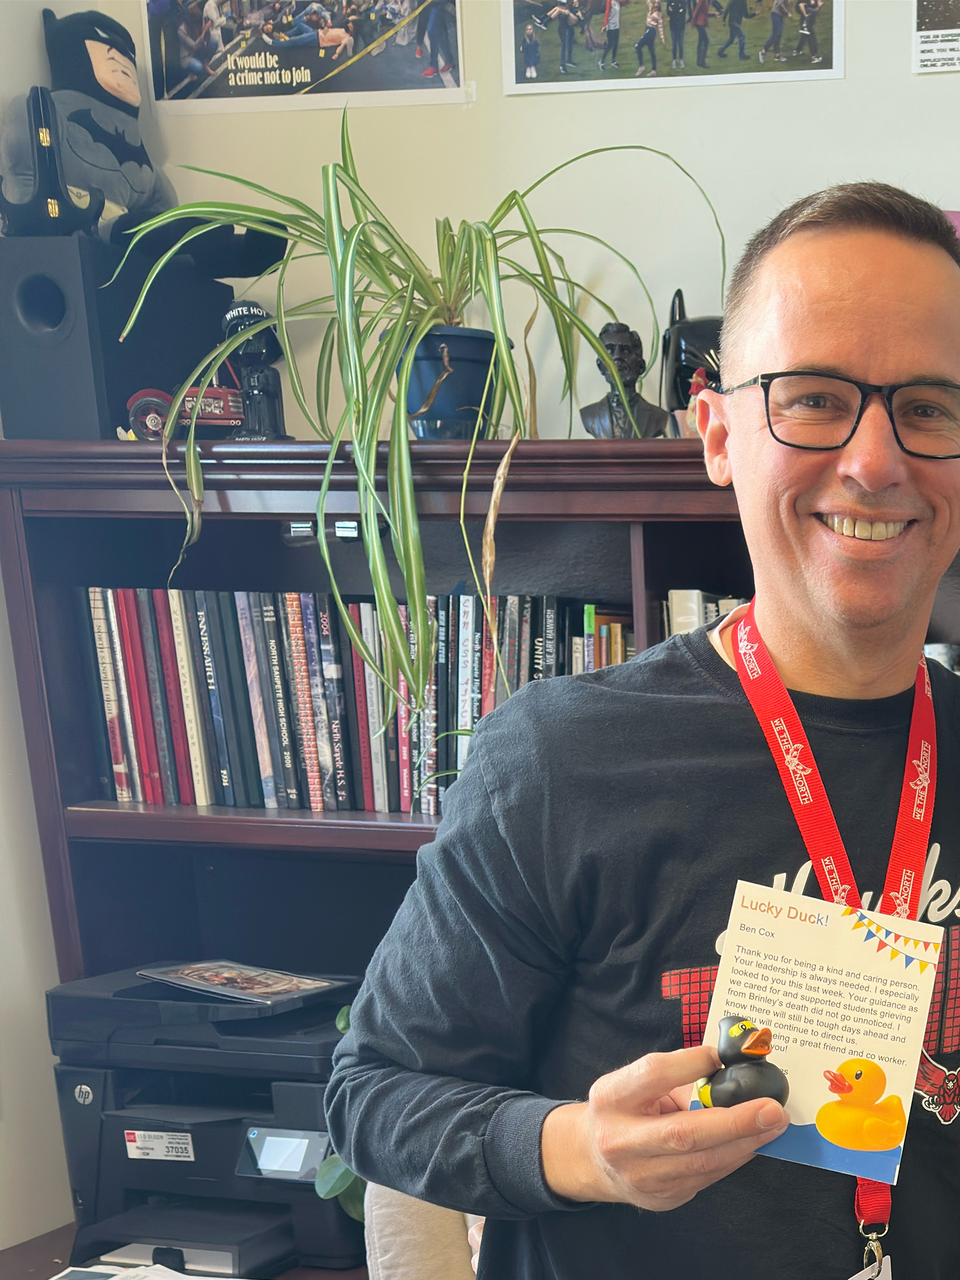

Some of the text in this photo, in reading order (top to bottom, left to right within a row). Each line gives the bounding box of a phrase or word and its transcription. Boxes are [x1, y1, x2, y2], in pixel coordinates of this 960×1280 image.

[227, 52, 279, 69] It would be
[228, 66, 311, 87] a crime not to join
[225, 306, 249, 321] WHITE
[319, 611, 329, 636] 2004
[545, 609, 556, 665] WE ARE HAWKS!!
[533, 637, 544, 671] UNITY
[744, 653, 761, 679] NORTH
[269, 639, 292, 768] NORTH SANPETE HIGH SCHOOL 2000
[773, 718, 811, 805] WE THE NORTH
[913, 740, 931, 821] WE THE NORTH
[823, 856, 840, 891] WE THE
[901, 869, 913, 900] NORTH
[741, 895, 829, 927] Lucky Duck!
[739, 923, 775, 939] Ben Cox
[734, 955, 920, 1003] Your leadership is always needed. especially
[736, 944, 920, 991] Thank you for being kind and caring person.
[729, 978, 912, 1024] we cared for and supported students grieving
[731, 966, 759, 979] looked
[761, 973, 769, 982] to
[771, 978, 787, 986] you
[788, 979, 803, 990] this
[805, 983, 820, 993] last
[821, 987, 846, 999] week.
[848, 992, 868, 1003] Your
[869, 998, 907, 1011] guidance
[725, 998, 907, 1044] know there will still be tough days ahead and
[727, 987, 895, 1030] from Brinley's death did not go unnoticed.
[759, 1017, 858, 1045] will continue to direct us.
[799, 1037, 908, 1067] great friend and co worker.
[78, 1084, 90, 1105] hp
[165, 1145, 189, 1154] 37035
